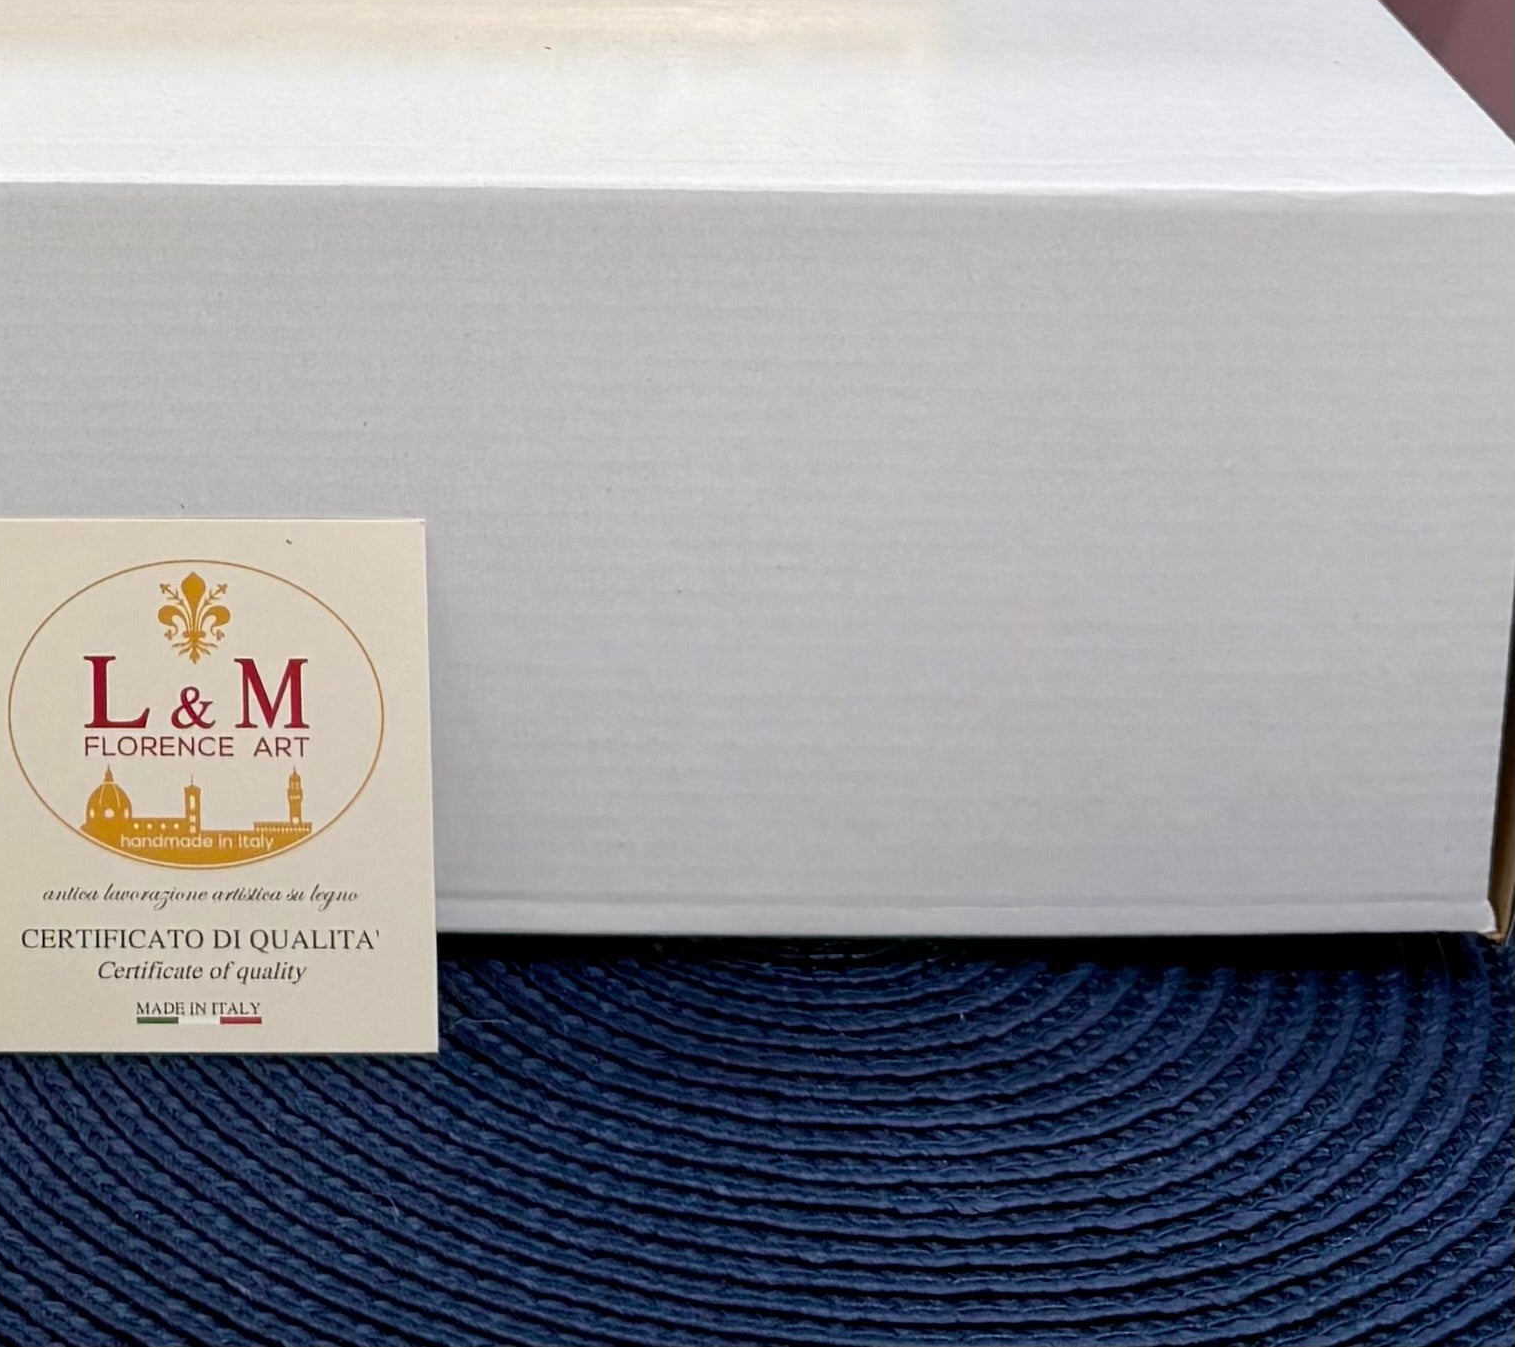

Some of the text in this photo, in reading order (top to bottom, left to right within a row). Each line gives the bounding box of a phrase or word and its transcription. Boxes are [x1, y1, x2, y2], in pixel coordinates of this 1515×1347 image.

[84, 656, 310, 729] L & M
[85, 736, 310, 757] FLORENCE ART
[121, 834, 274, 850] handmade in Italy
[286, 889, 305, 901] su
[21, 929, 379, 953] CERTIFICATO DI QUALITA'
[97, 961, 307, 984] Certificate of quality
[136, 1002, 260, 1015] MADE IN ITALY
